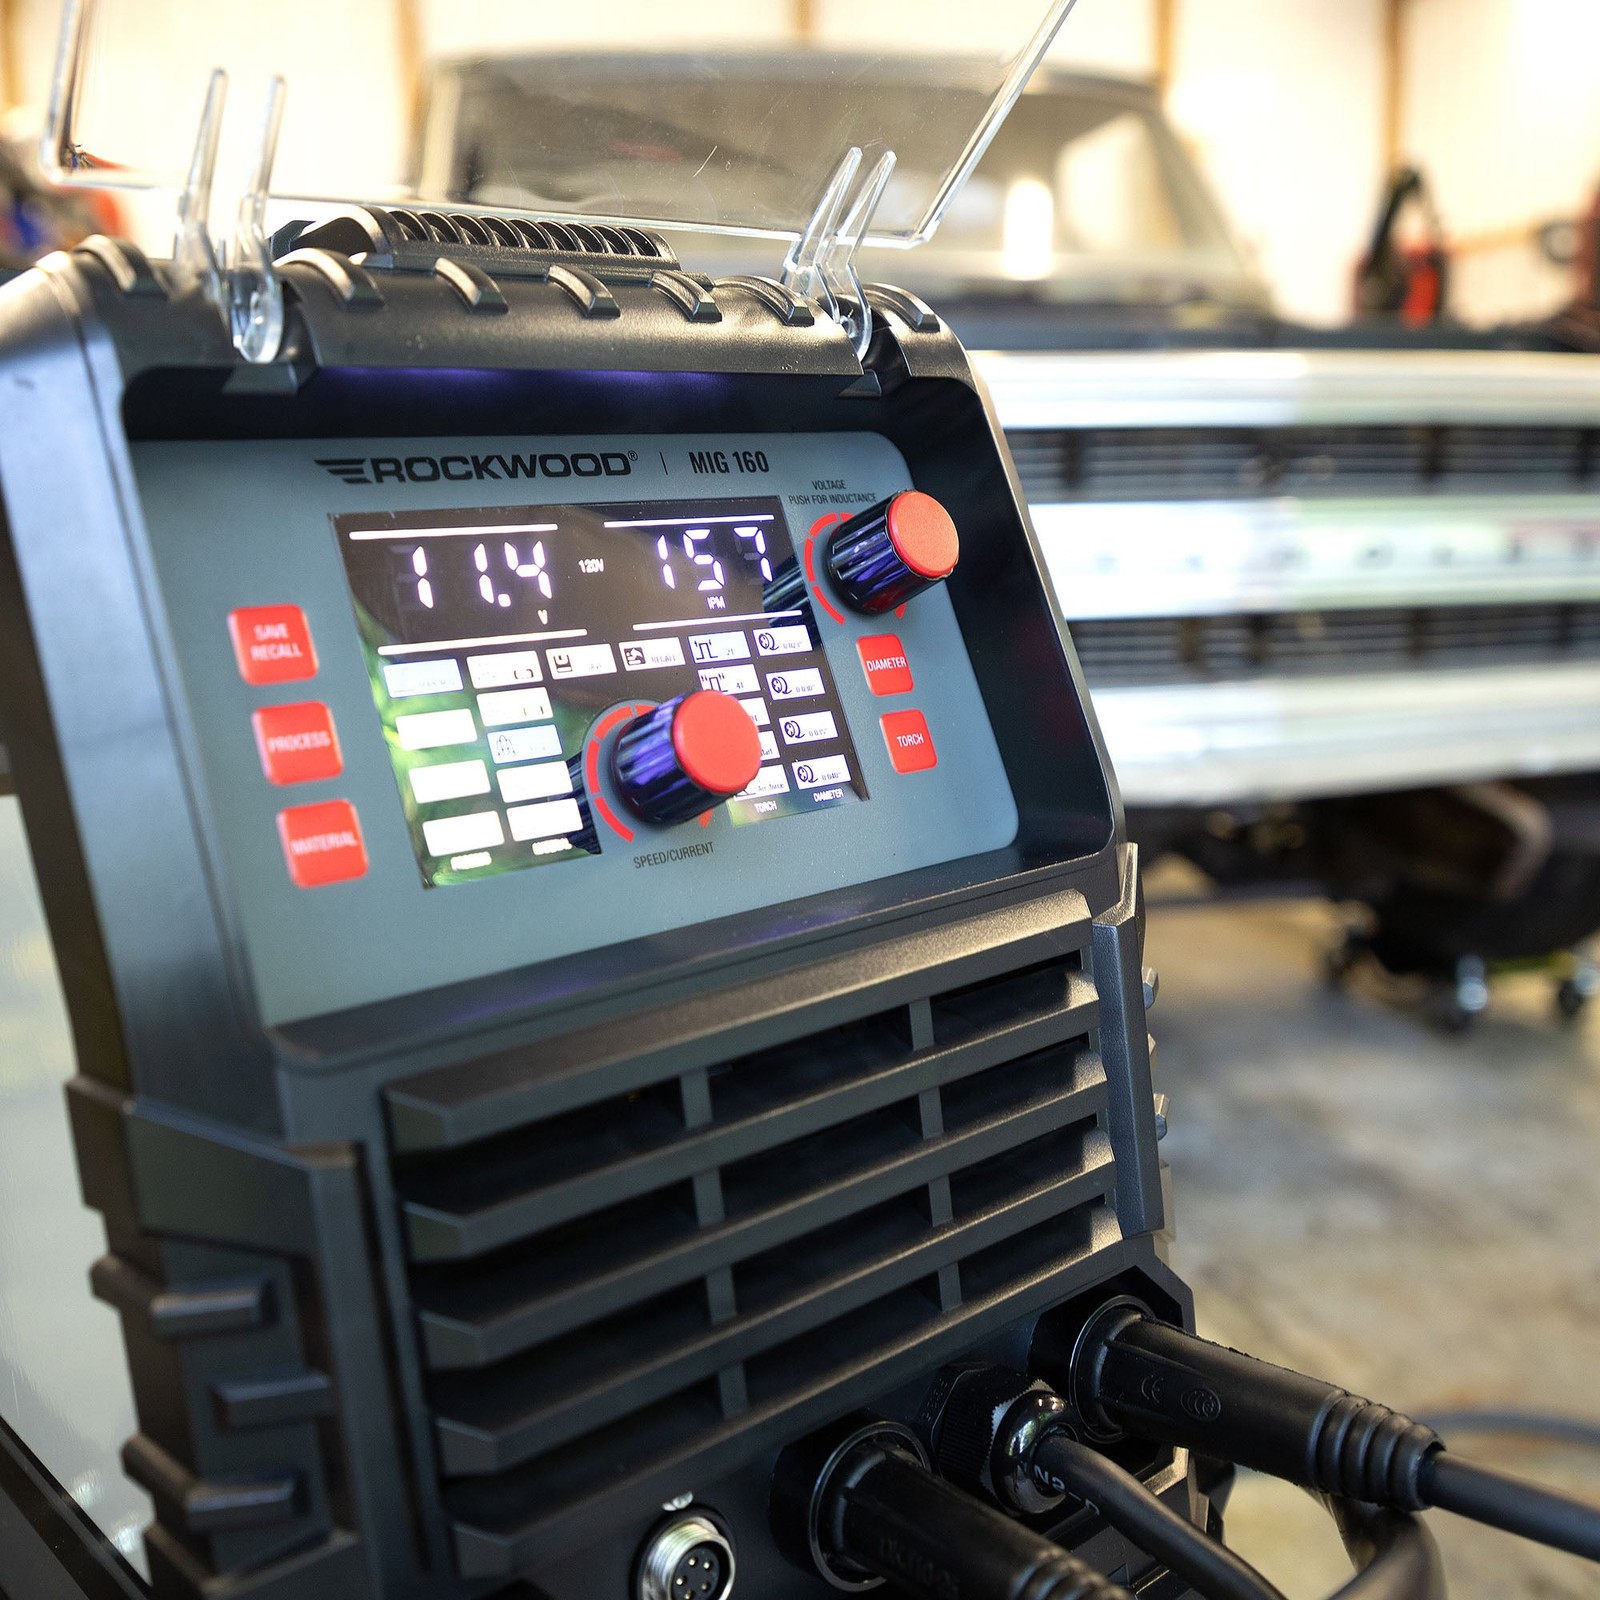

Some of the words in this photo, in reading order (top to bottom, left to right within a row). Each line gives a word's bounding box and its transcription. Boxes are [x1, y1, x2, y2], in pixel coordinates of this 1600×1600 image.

[689, 452, 730, 474] MIG
[733, 451, 769, 473] 160
[812, 480, 846, 490] VOLTAGE
[788, 494, 810, 505] PUSH
[812, 494, 828, 505] FOR
[829, 492, 877, 504] INDUCTANCE
[657, 527, 773, 591] 157
[253, 623, 289, 641] SAVE
[250, 643, 303, 661] RECALL
[866, 656, 907, 672] DIAMETER
[267, 730, 331, 752] PROCESS
[896, 733, 924, 747] TORCH
[813, 788, 844, 802] DIAMETER
[754, 801, 777, 813] TORCH
[291, 831, 357, 856] MATERIAL
[633, 842, 715, 869] SPEED/CURRENT
